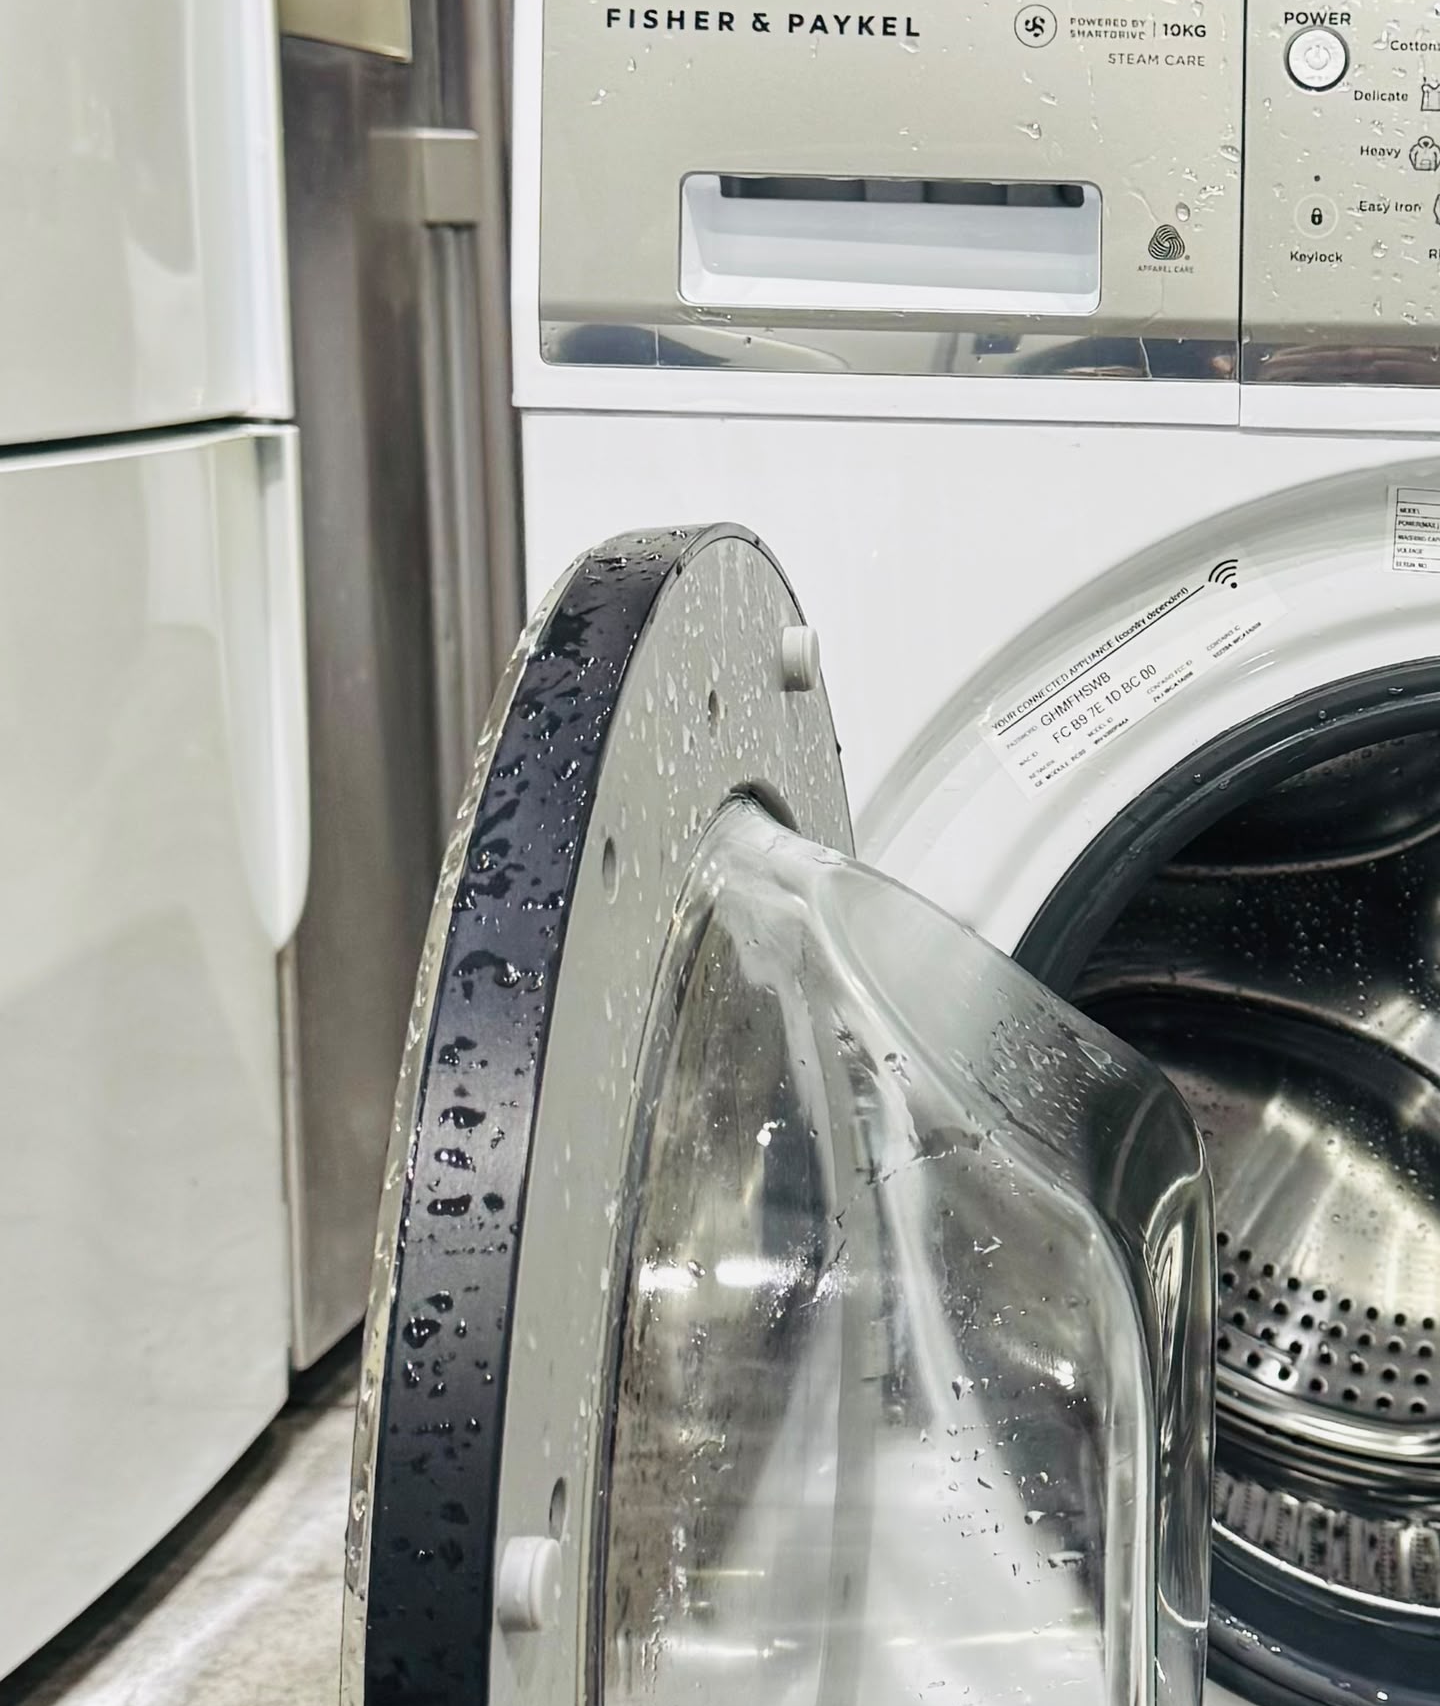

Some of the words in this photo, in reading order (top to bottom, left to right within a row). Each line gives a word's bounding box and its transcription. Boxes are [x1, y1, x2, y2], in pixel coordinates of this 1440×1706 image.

[606, 7, 736, 33] FISHER
[751, 11, 771, 34] &
[787, 13, 921, 39] PAYKEL
[1284, 12, 1352, 26] POWER
[1163, 23, 1207, 38] 10KG
[1108, 53, 1160, 66] STEAM
[1164, 55, 1206, 67] CARE
[1354, 90, 1409, 102] Delicate
[1360, 144, 1402, 160] Heavy
[1359, 200, 1390, 215] Easy
[1395, 201, 1422, 213] Iron
[1290, 251, 1343, 266] Keylock
[1052, 725, 1072, 744] FC
[1086, 701, 1106, 717] 7E
[1121, 675, 1141, 694] BC
[1139, 664, 1157, 681] 00
